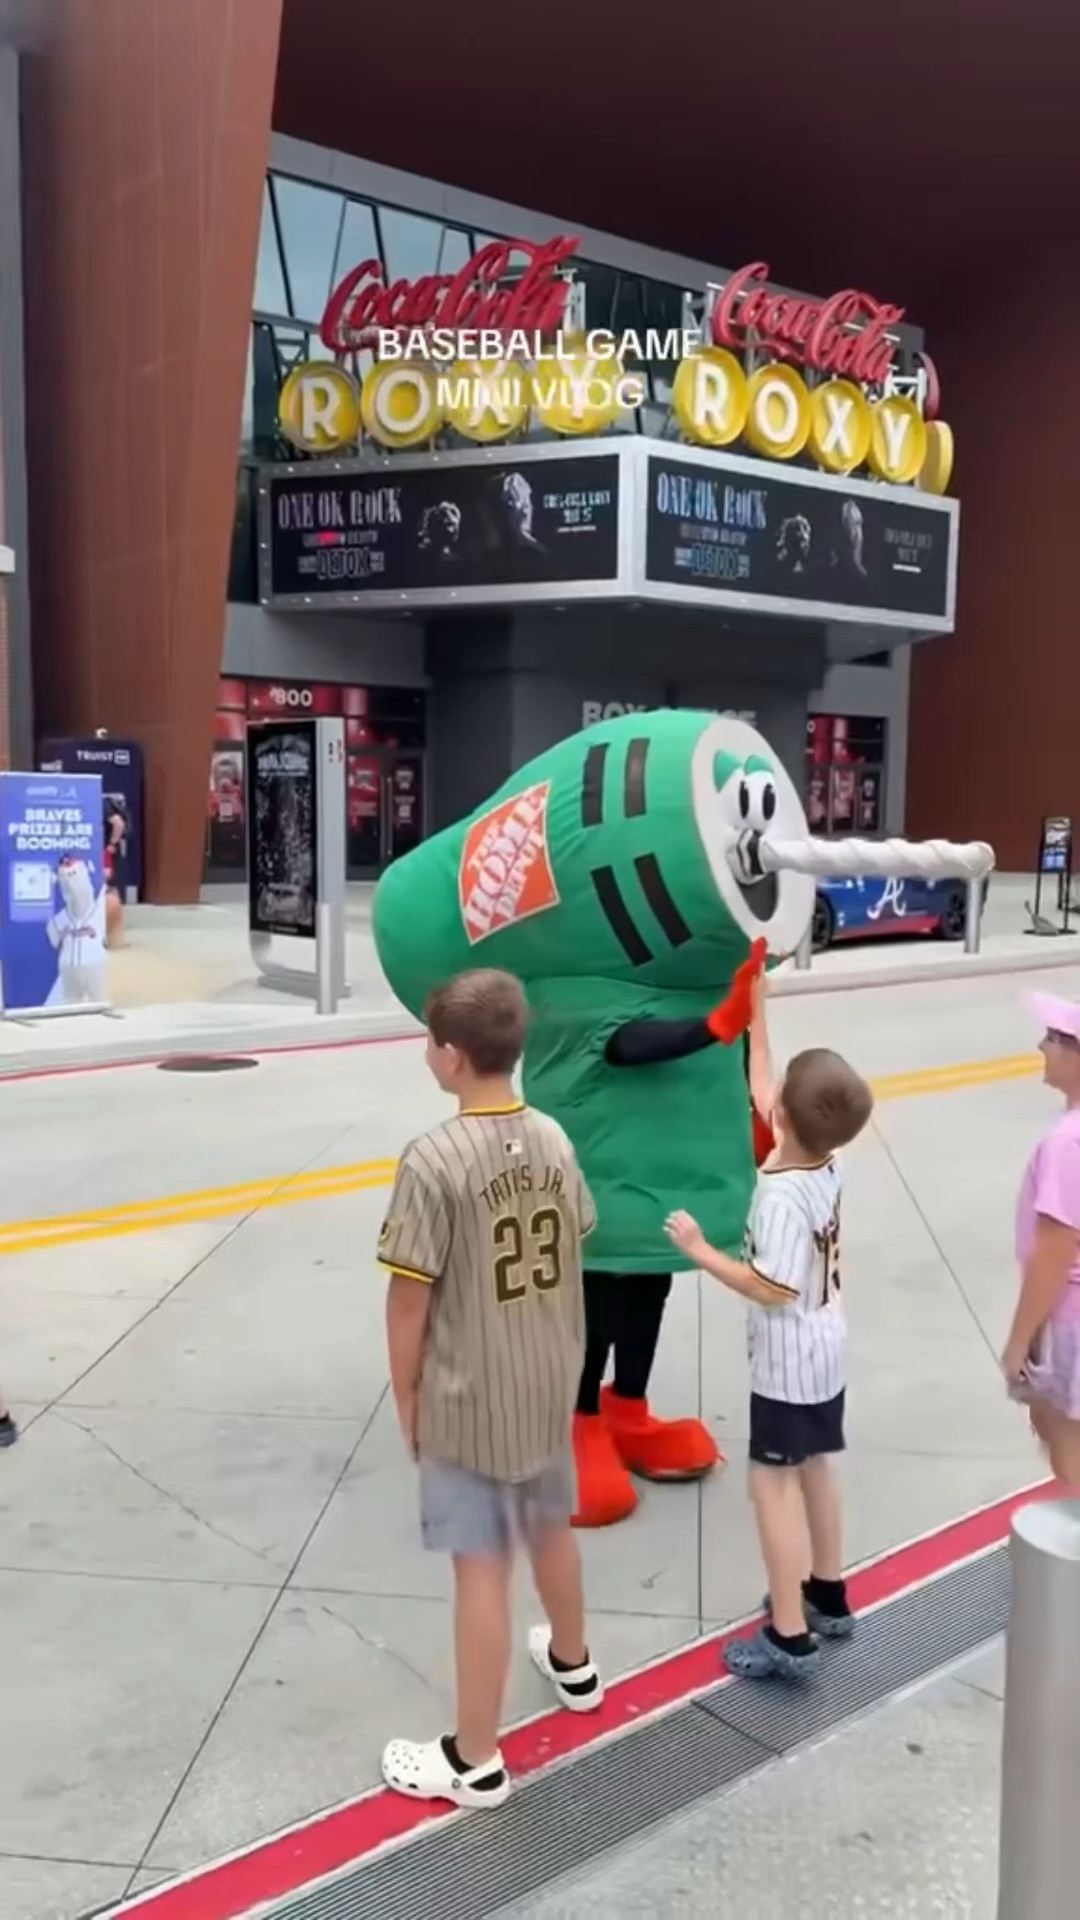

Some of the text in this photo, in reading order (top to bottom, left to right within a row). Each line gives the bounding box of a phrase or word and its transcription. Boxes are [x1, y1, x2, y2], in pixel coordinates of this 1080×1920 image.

[692, 361, 911, 472] ROXY
[279, 487, 402, 530] ONE OK ROCK
[657, 472, 692, 518] ONE
[695, 480, 718, 522] OK
[723, 485, 768, 529] ROCK
[77, 750, 114, 762] TRUIST
[8, 822, 93, 837] PRIZES ARE
[25, 808, 82, 822] BRAVES
[16, 836, 92, 851] BOOMING
[465, 792, 545, 932] HOME
[494, 824, 545, 920] DEPOT
[479, 1164, 566, 1213] TATIS JR.
[493, 1206, 563, 1304] 23
